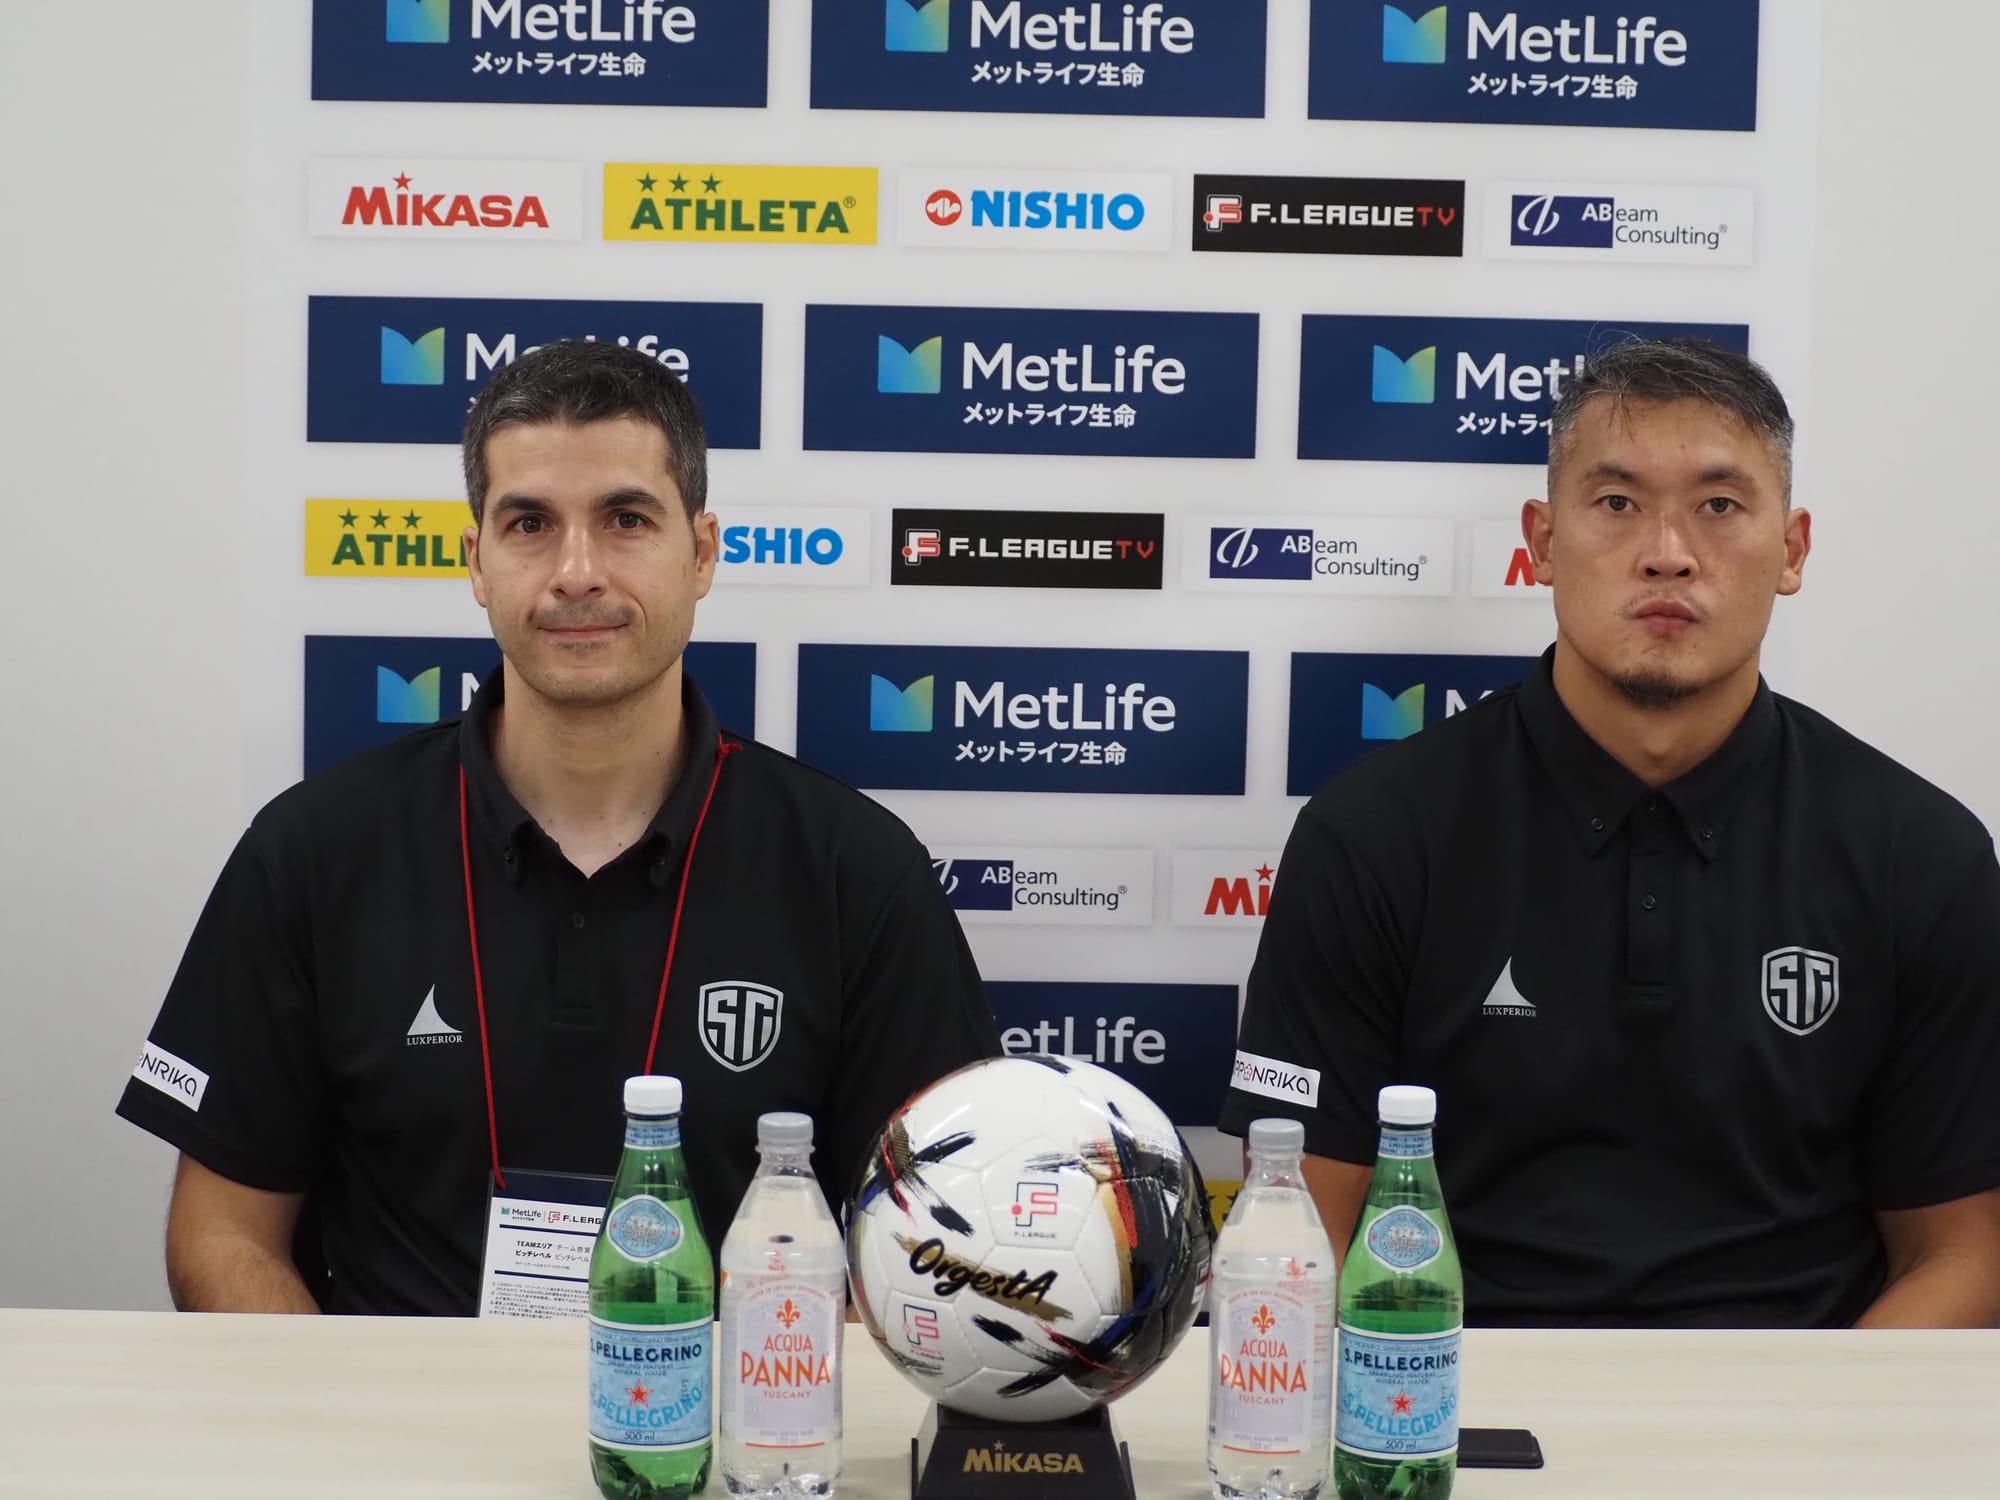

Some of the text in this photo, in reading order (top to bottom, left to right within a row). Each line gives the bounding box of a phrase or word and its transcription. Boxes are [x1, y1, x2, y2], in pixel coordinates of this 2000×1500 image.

[471, 0, 697, 43] MetLife
[970, 0, 1195, 54] MetLife
[1467, 11, 1688, 66] MetLife
[471, 51, 647, 78] メットライフ生命
[971, 60, 1146, 88] メットライフ生命
[1467, 72, 1639, 100] メットライフ生命
[971, 189, 1145, 231] NISHIO
[962, 341, 1186, 395] MetLife
[963, 402, 1137, 429] メットライフ生命
[1456, 411, 1554, 436] メットライ
[331, 533, 468, 568] ATHL
[716, 525, 844, 566] SHIO
[954, 680, 1176, 732] MetLife
[955, 740, 1128, 766] メットライフ生命
[1482, 1006, 1537, 1017] LUXPERIOR
[406, 1035, 463, 1046] LUXPERIOR
[999, 1016, 1166, 1065] etLife
[512, 1208, 541, 1218] MetLife
[563, 1215, 602, 1225] F.LEAG
[763, 1334, 814, 1353] ACQUA
[1239, 1339, 1289, 1359] ACQUA
[740, 1350, 831, 1388] PANNA
[1344, 1347, 1458, 1371] S.PELLEGRINO
[1220, 1352, 1308, 1394] PANNA
[763, 1390, 811, 1400] TUSCANY
[1238, 1394, 1286, 1405] TUSCANY
[624, 1431, 641, 1441] 500
[1385, 1440, 1404, 1450] 500
